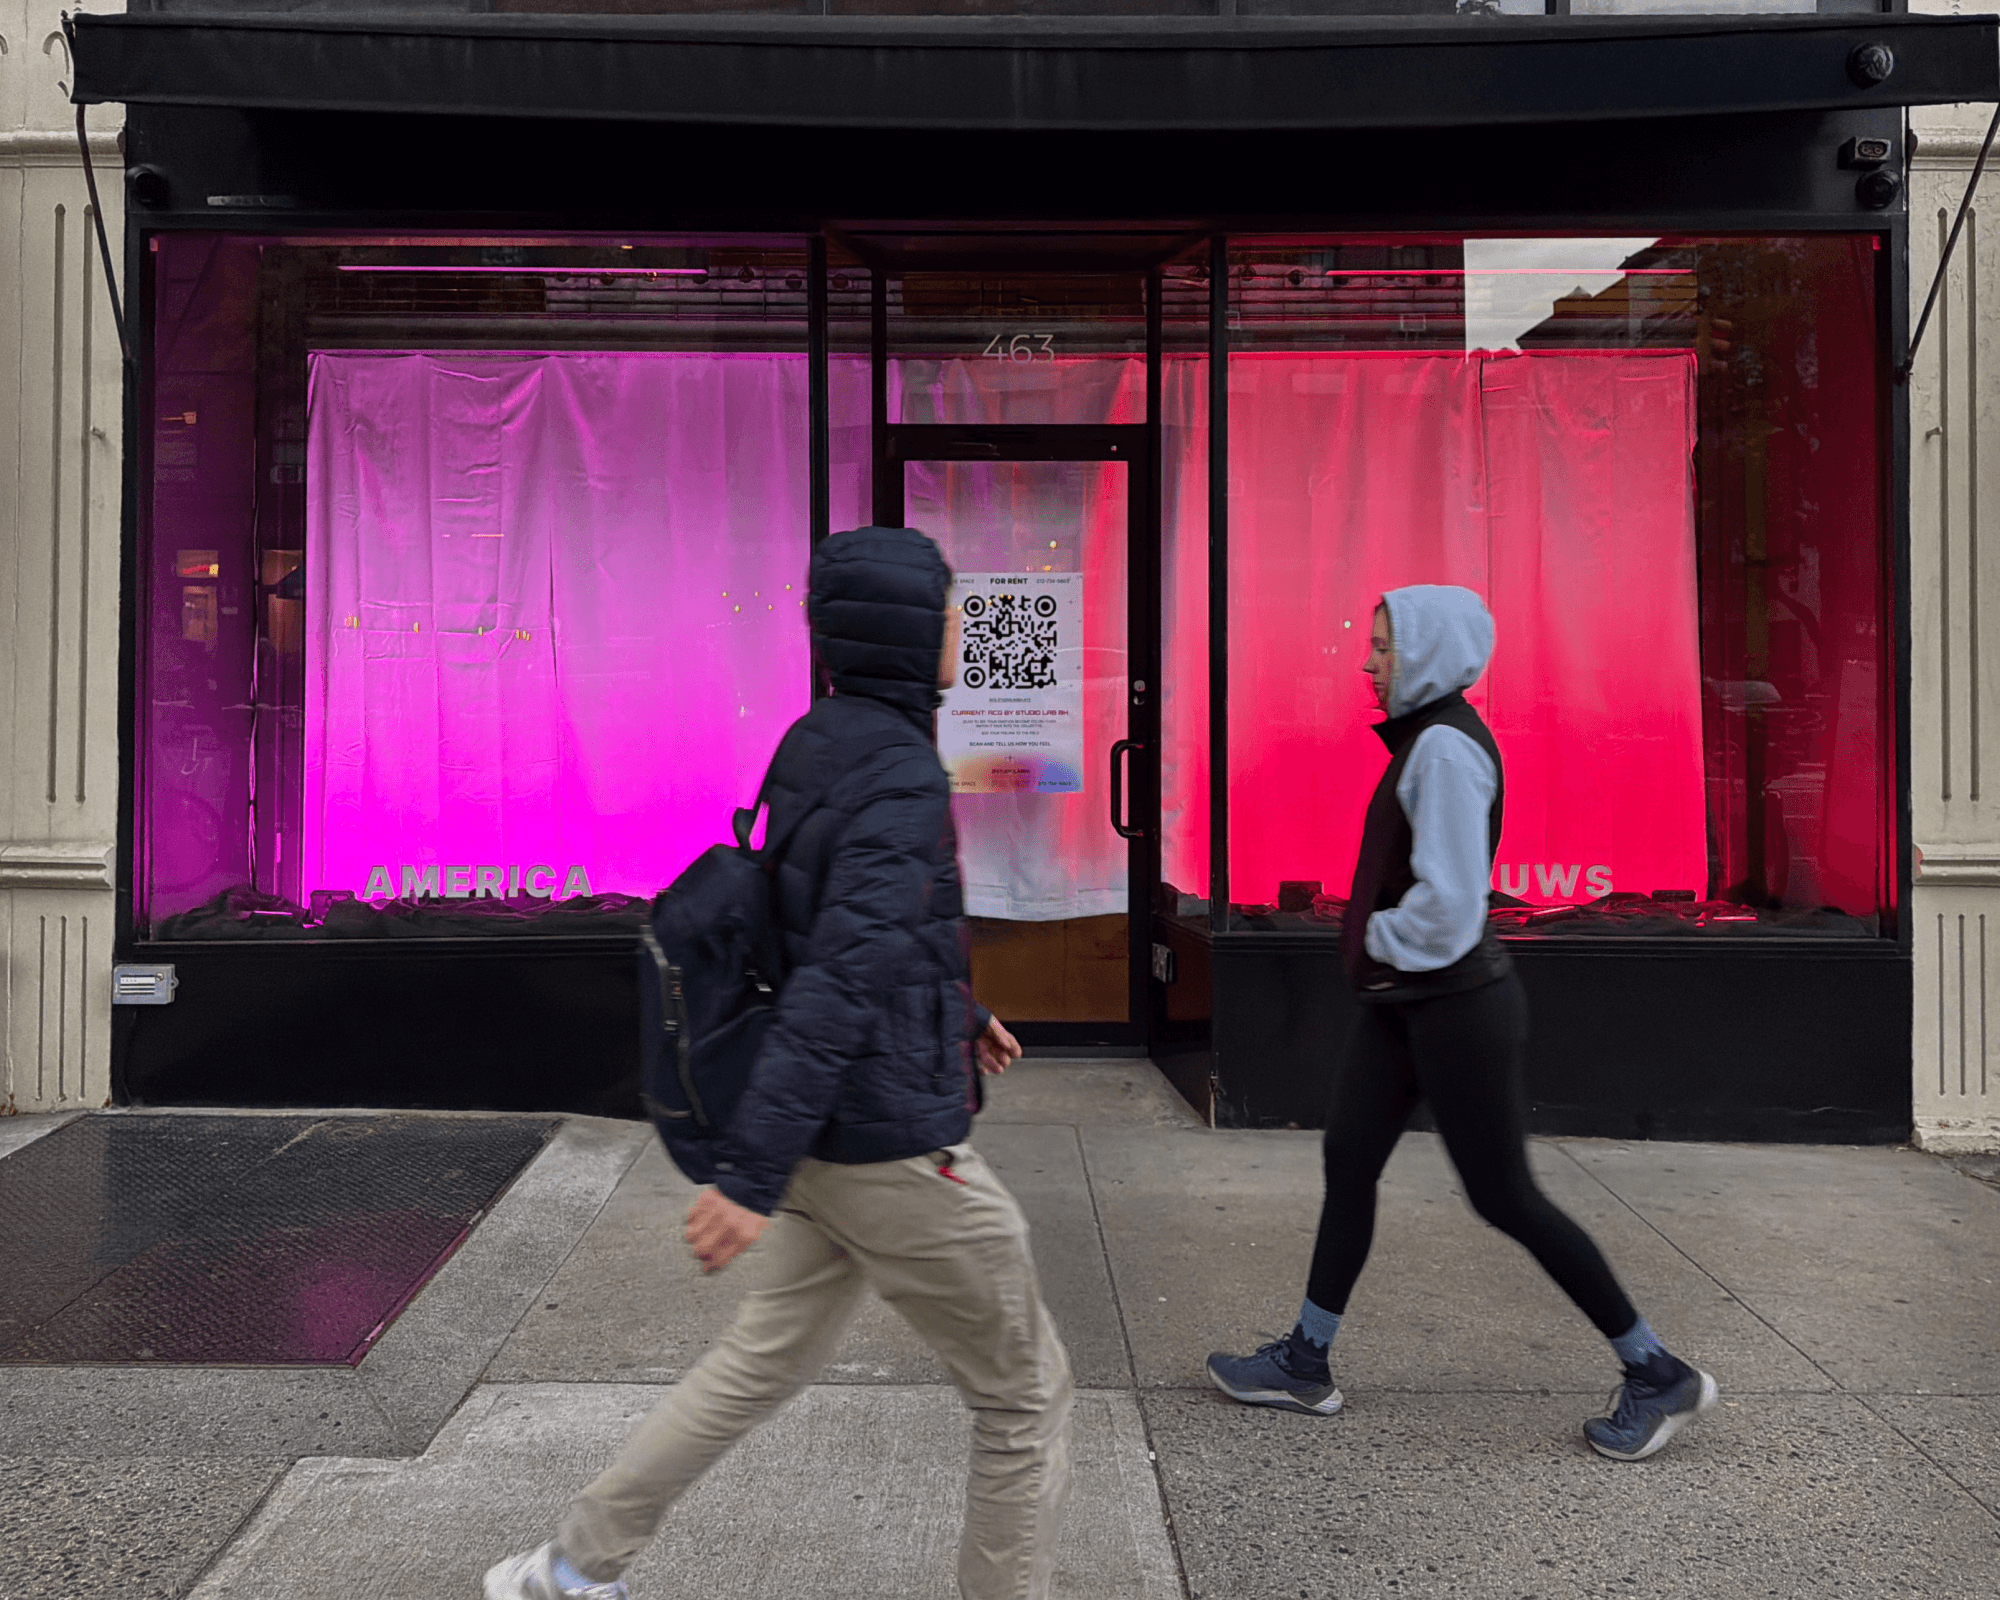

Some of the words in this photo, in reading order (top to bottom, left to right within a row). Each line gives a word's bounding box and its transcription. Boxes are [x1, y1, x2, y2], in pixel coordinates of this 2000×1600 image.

[982, 334, 1054, 364] 463
[990, 577, 1006, 585] FOR
[1007, 577, 1028, 585] RENT
[362, 864, 593, 899] AMERICA
[1500, 863, 1613, 898] UWS
